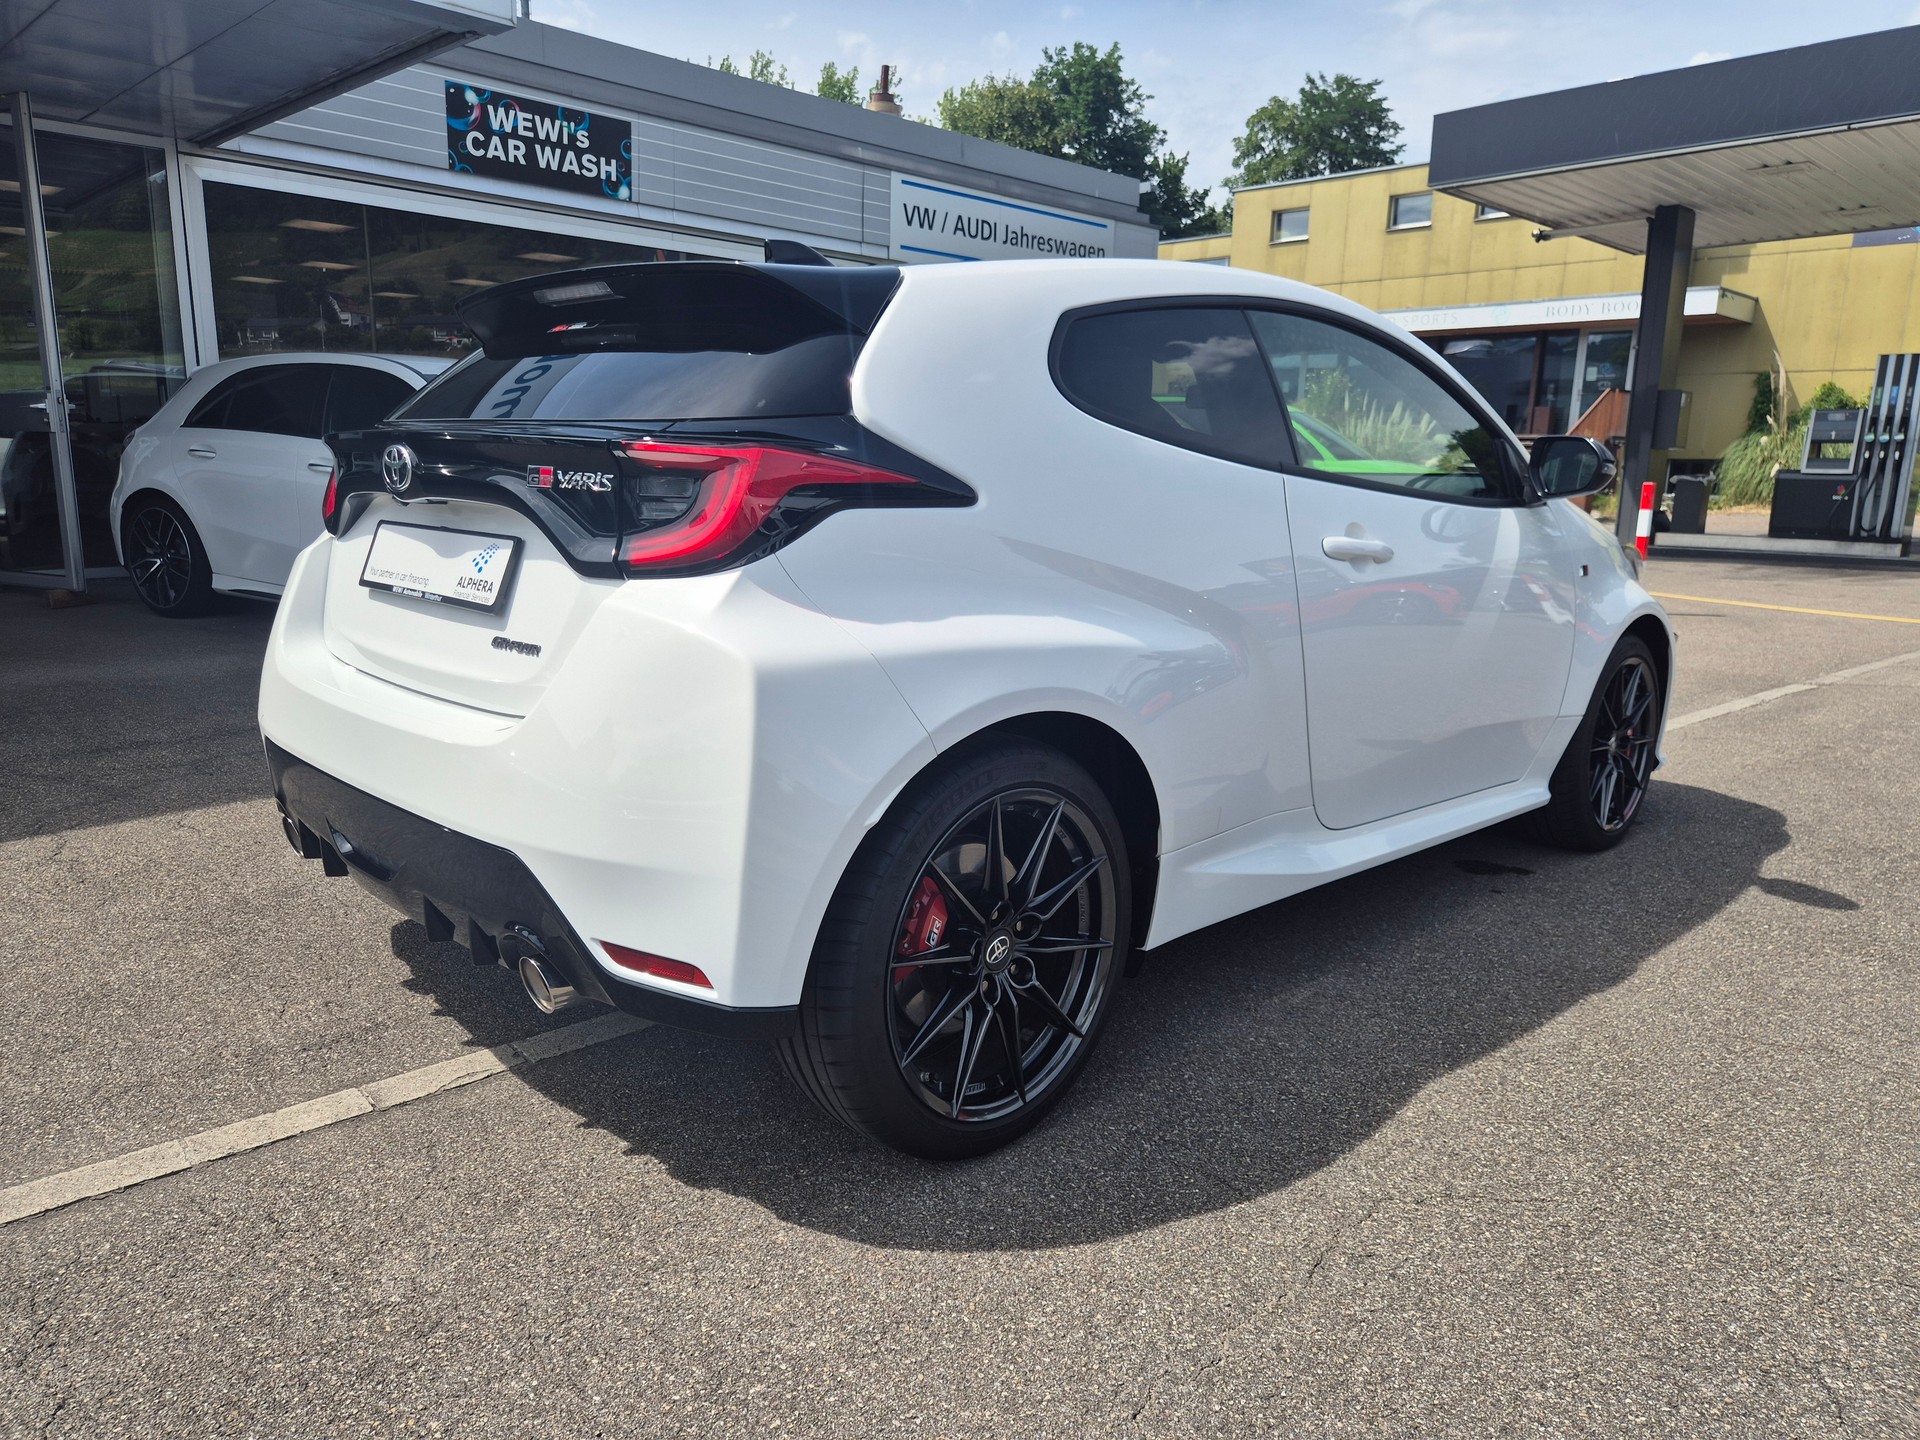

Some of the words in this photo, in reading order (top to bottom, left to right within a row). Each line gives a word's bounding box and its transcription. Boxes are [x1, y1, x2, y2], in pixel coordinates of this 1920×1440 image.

[487, 105, 590, 149] WEWi's
[466, 131, 526, 165] CAR
[535, 144, 617, 182] WASH
[903, 203, 937, 231] VW
[941, 211, 949, 234] /
[952, 214, 997, 243] AUDI
[1003, 224, 1105, 258] Jahreswagen
[1402, 311, 1457, 327] SPORTS
[1546, 303, 1595, 318] BODY
[527, 469, 553, 487] GR
[556, 470, 614, 491] YARIS
[456, 576, 494, 593] ALPHERA
[453, 590, 471, 600] Financial
[471, 593, 491, 604] Services
